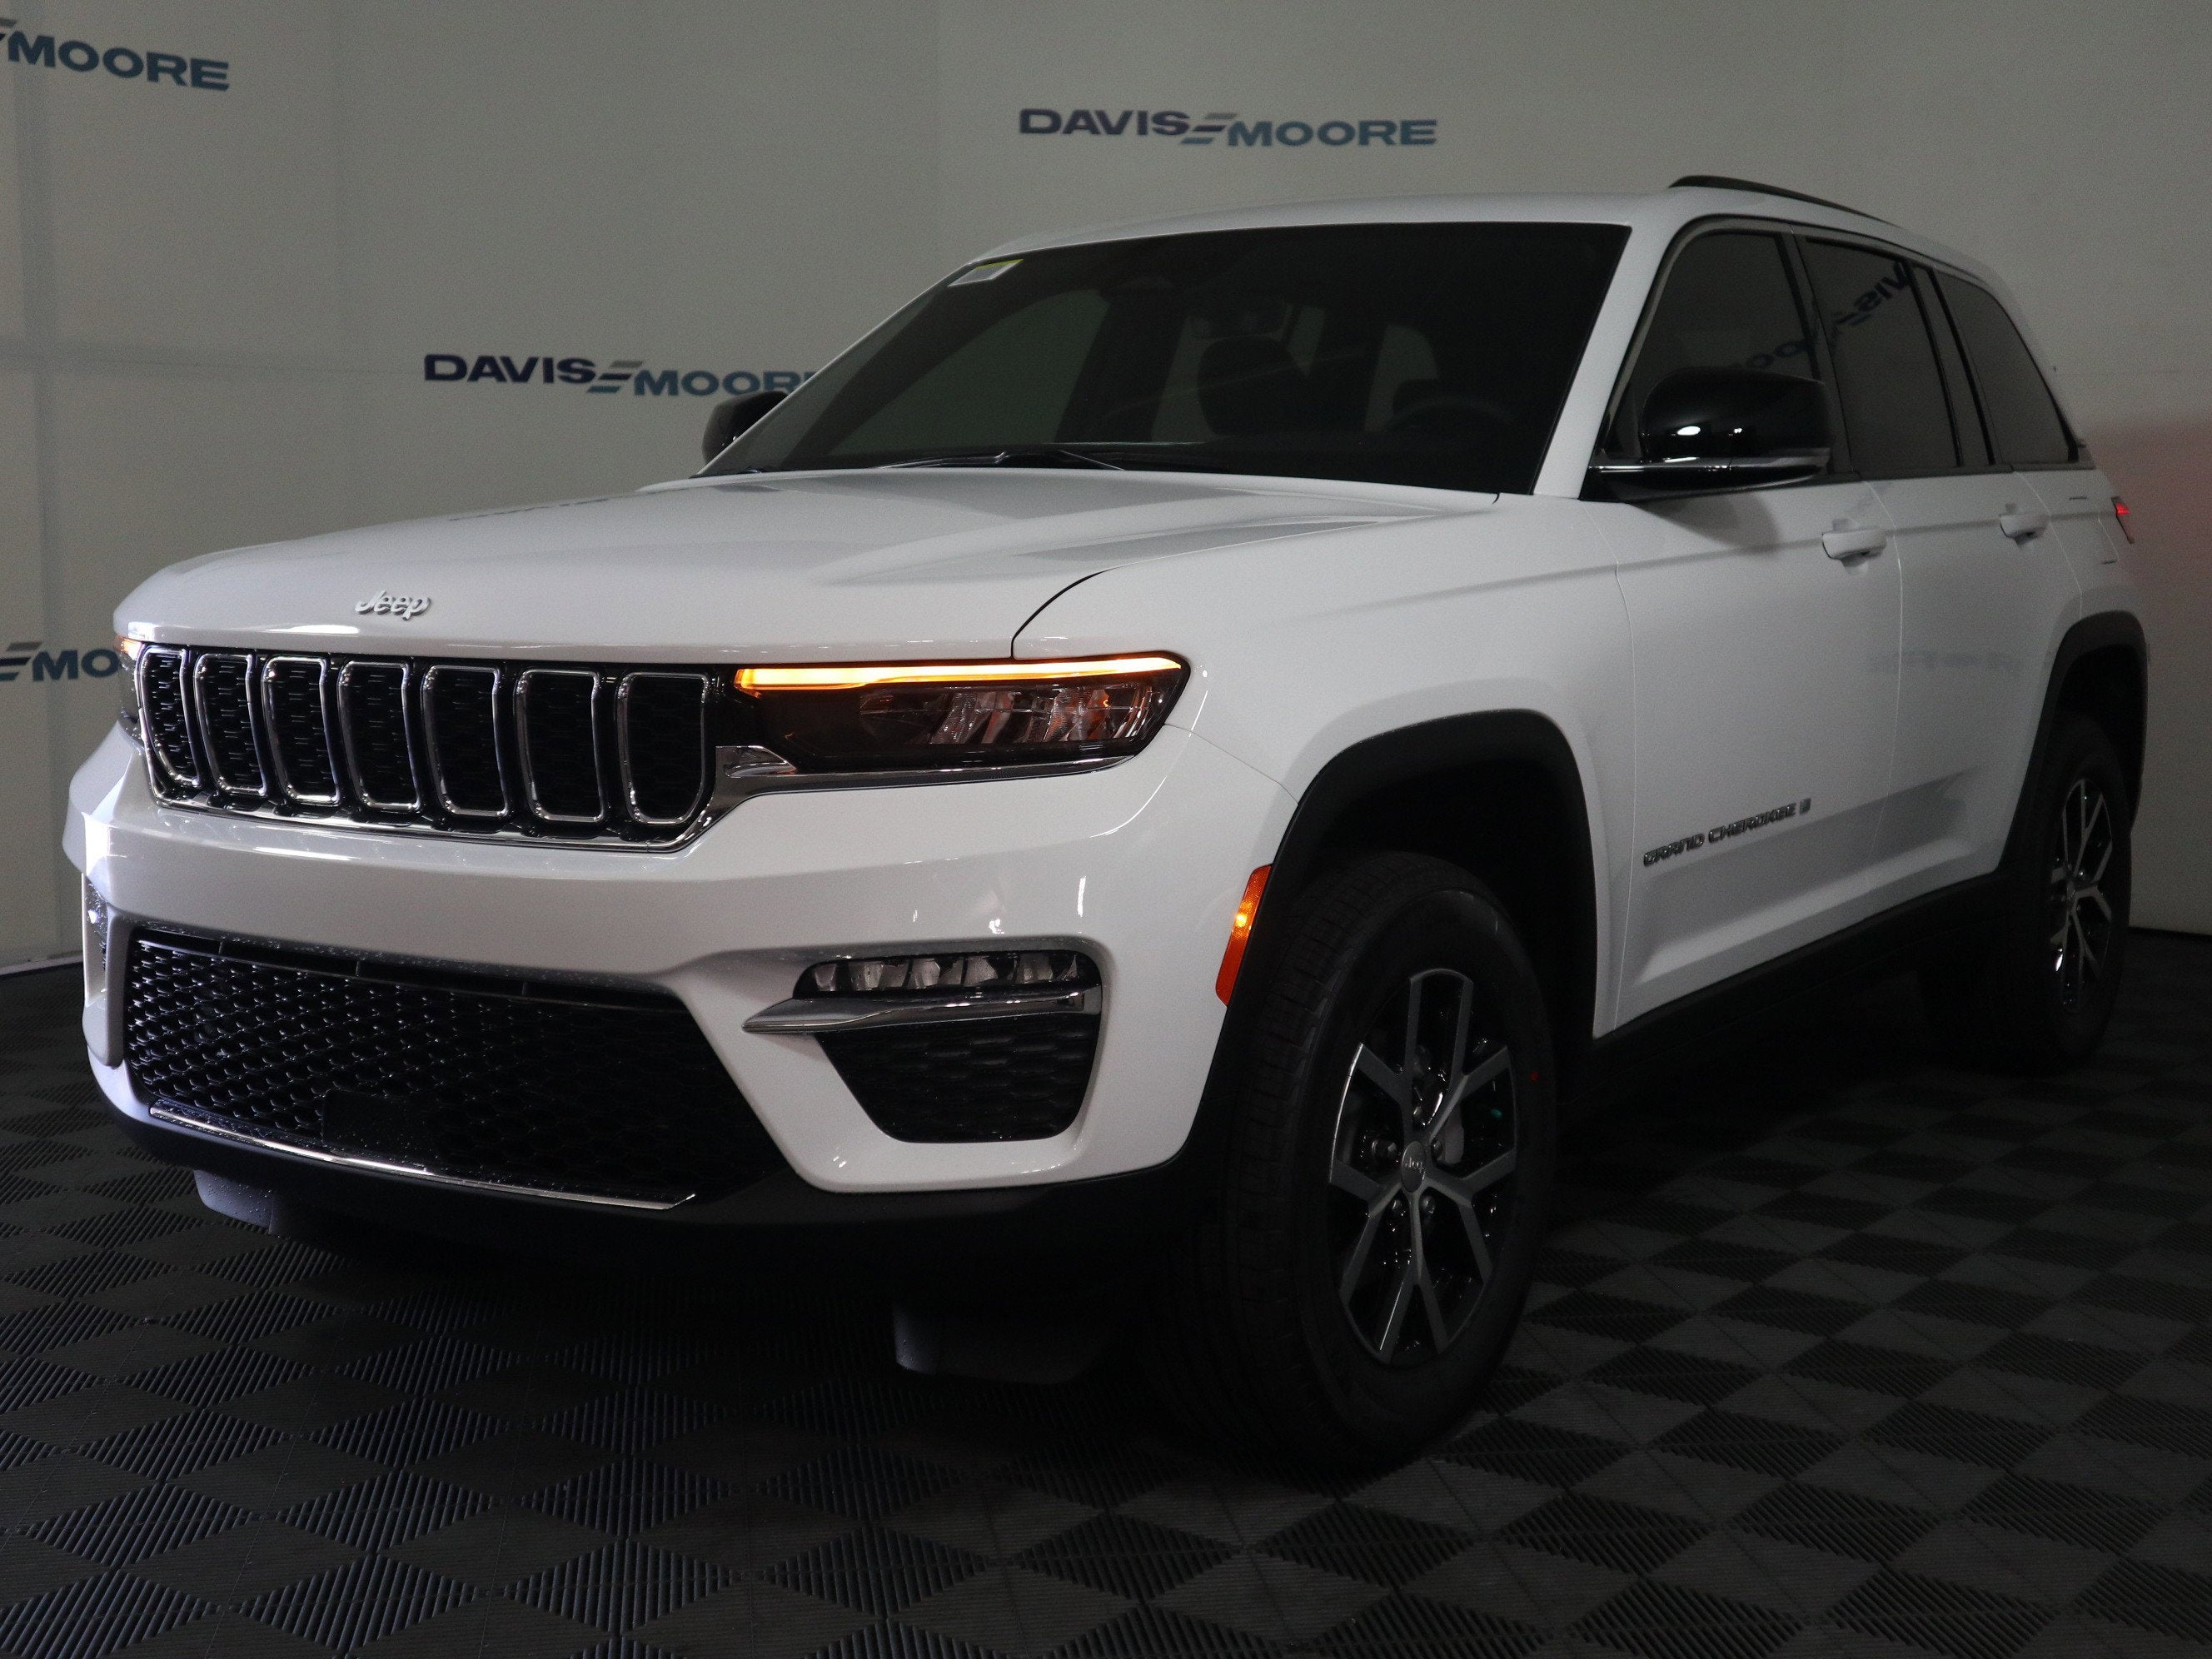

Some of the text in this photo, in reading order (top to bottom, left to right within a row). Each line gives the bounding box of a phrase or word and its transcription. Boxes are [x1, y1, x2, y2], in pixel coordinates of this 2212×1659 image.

[7, 30, 229, 91] MOORE
[1019, 108, 1437, 147] DAVIS MOORE
[424, 354, 819, 396] DAVIS MOOR
[355, 590, 431, 621] Jeep
[1643, 802, 1797, 867] GRAND CHEROKEE
